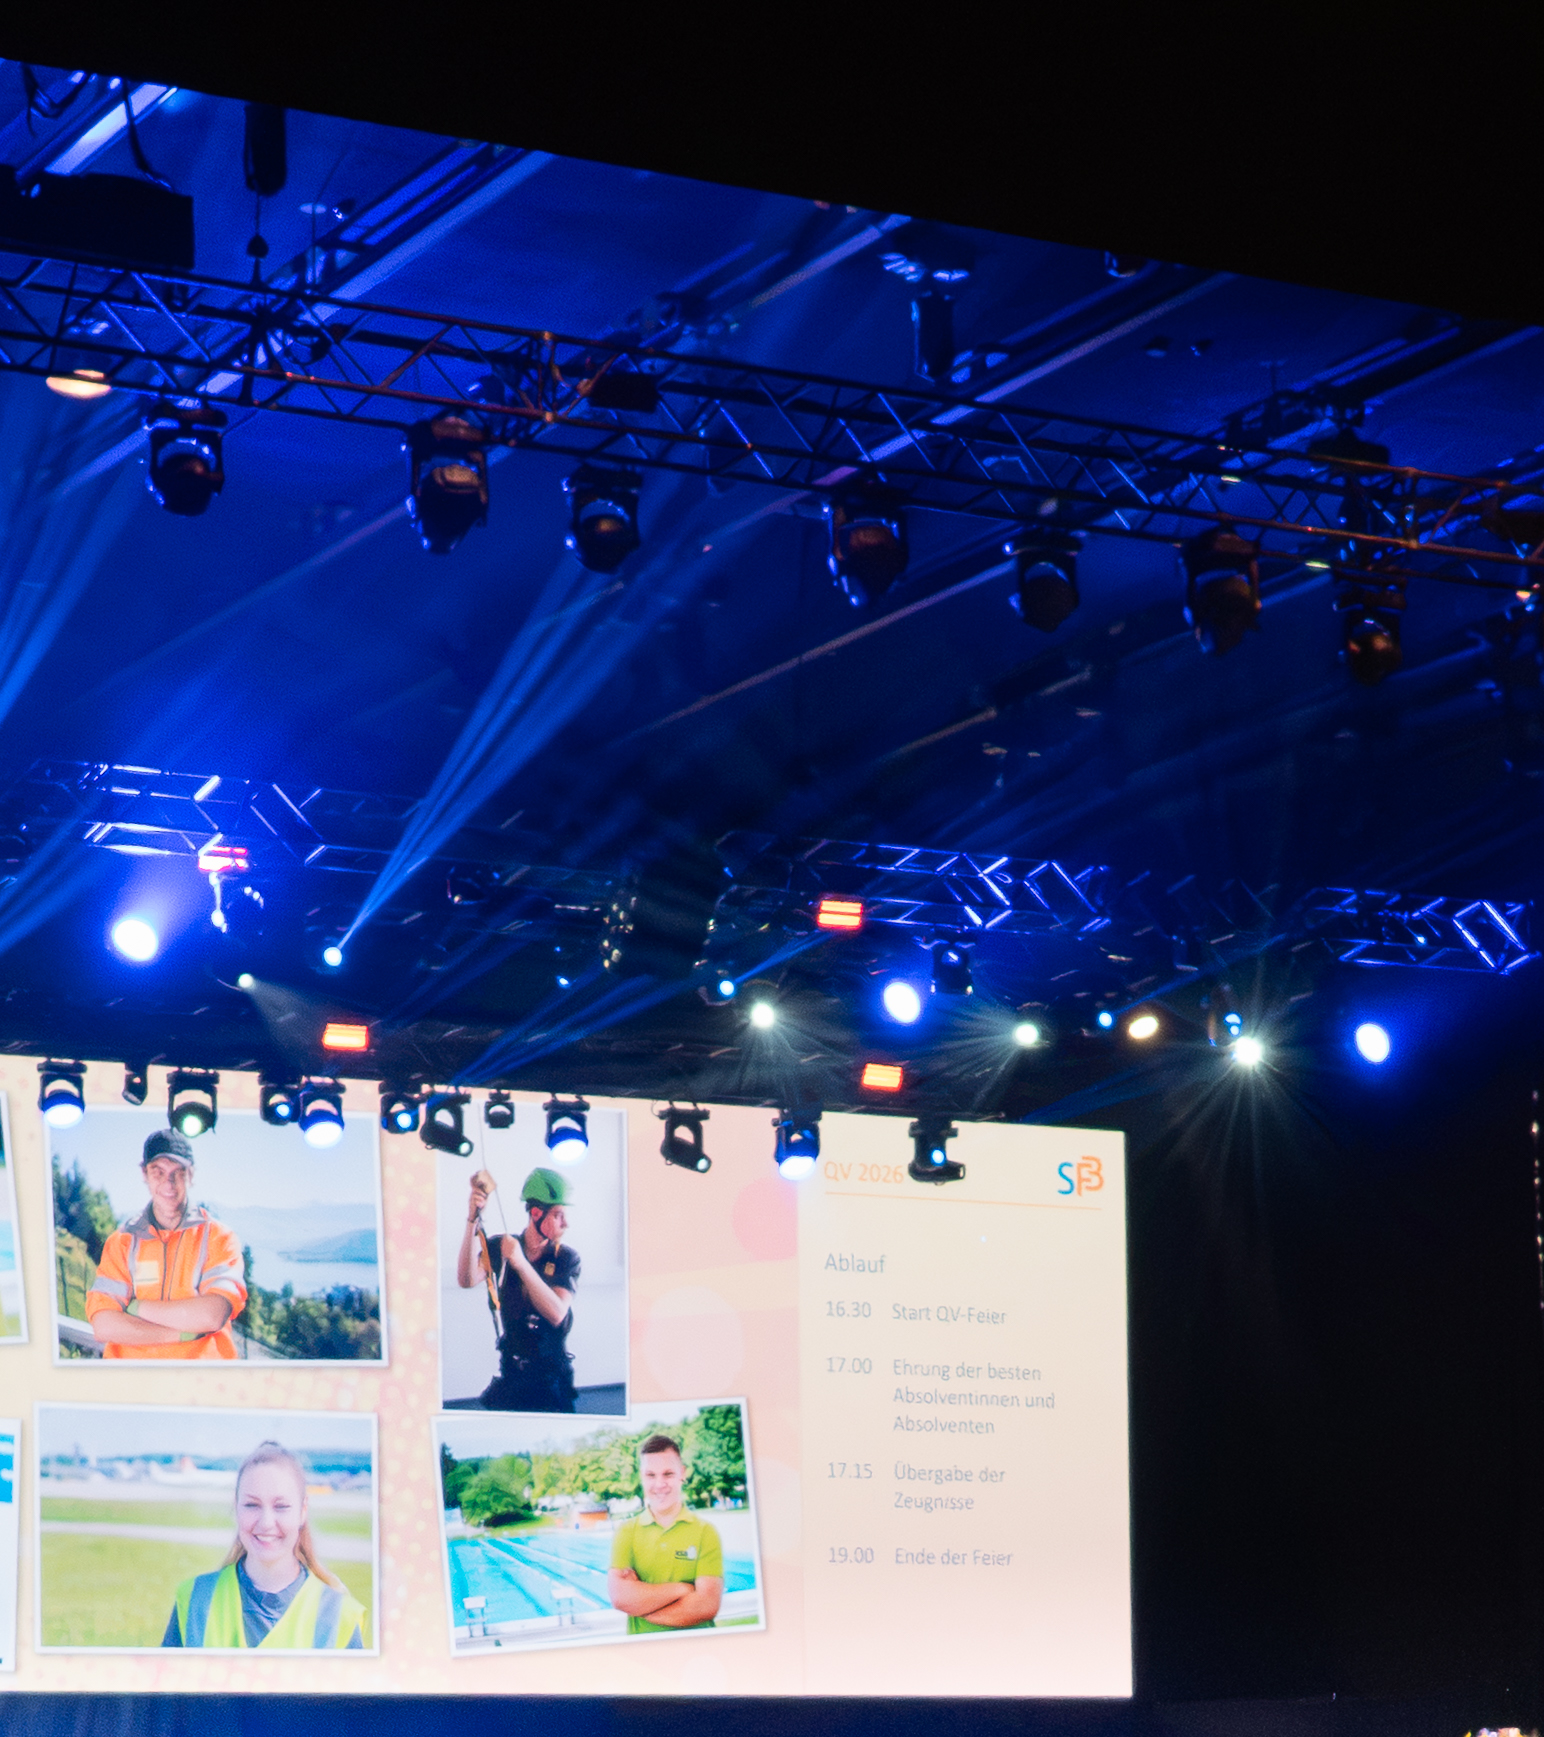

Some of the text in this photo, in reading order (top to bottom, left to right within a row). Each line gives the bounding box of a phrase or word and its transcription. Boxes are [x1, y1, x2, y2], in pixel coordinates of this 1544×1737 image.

[824, 1161, 905, 1184] QV 2026
[824, 1253, 887, 1274] Ablauf
[826, 1301, 1007, 1325] 16.30 Start QV-Feier
[826, 1357, 1042, 1381] 17.00 Ehrung der besten
[893, 1386, 1055, 1409] Absolventinnen und
[893, 1415, 995, 1434] Absolventen
[827, 1460, 1006, 1485] 17.15 Übergabe der
[894, 1491, 975, 1513] Zeugnisse
[828, 1547, 1013, 1566] 19.00 Ende der Feier
